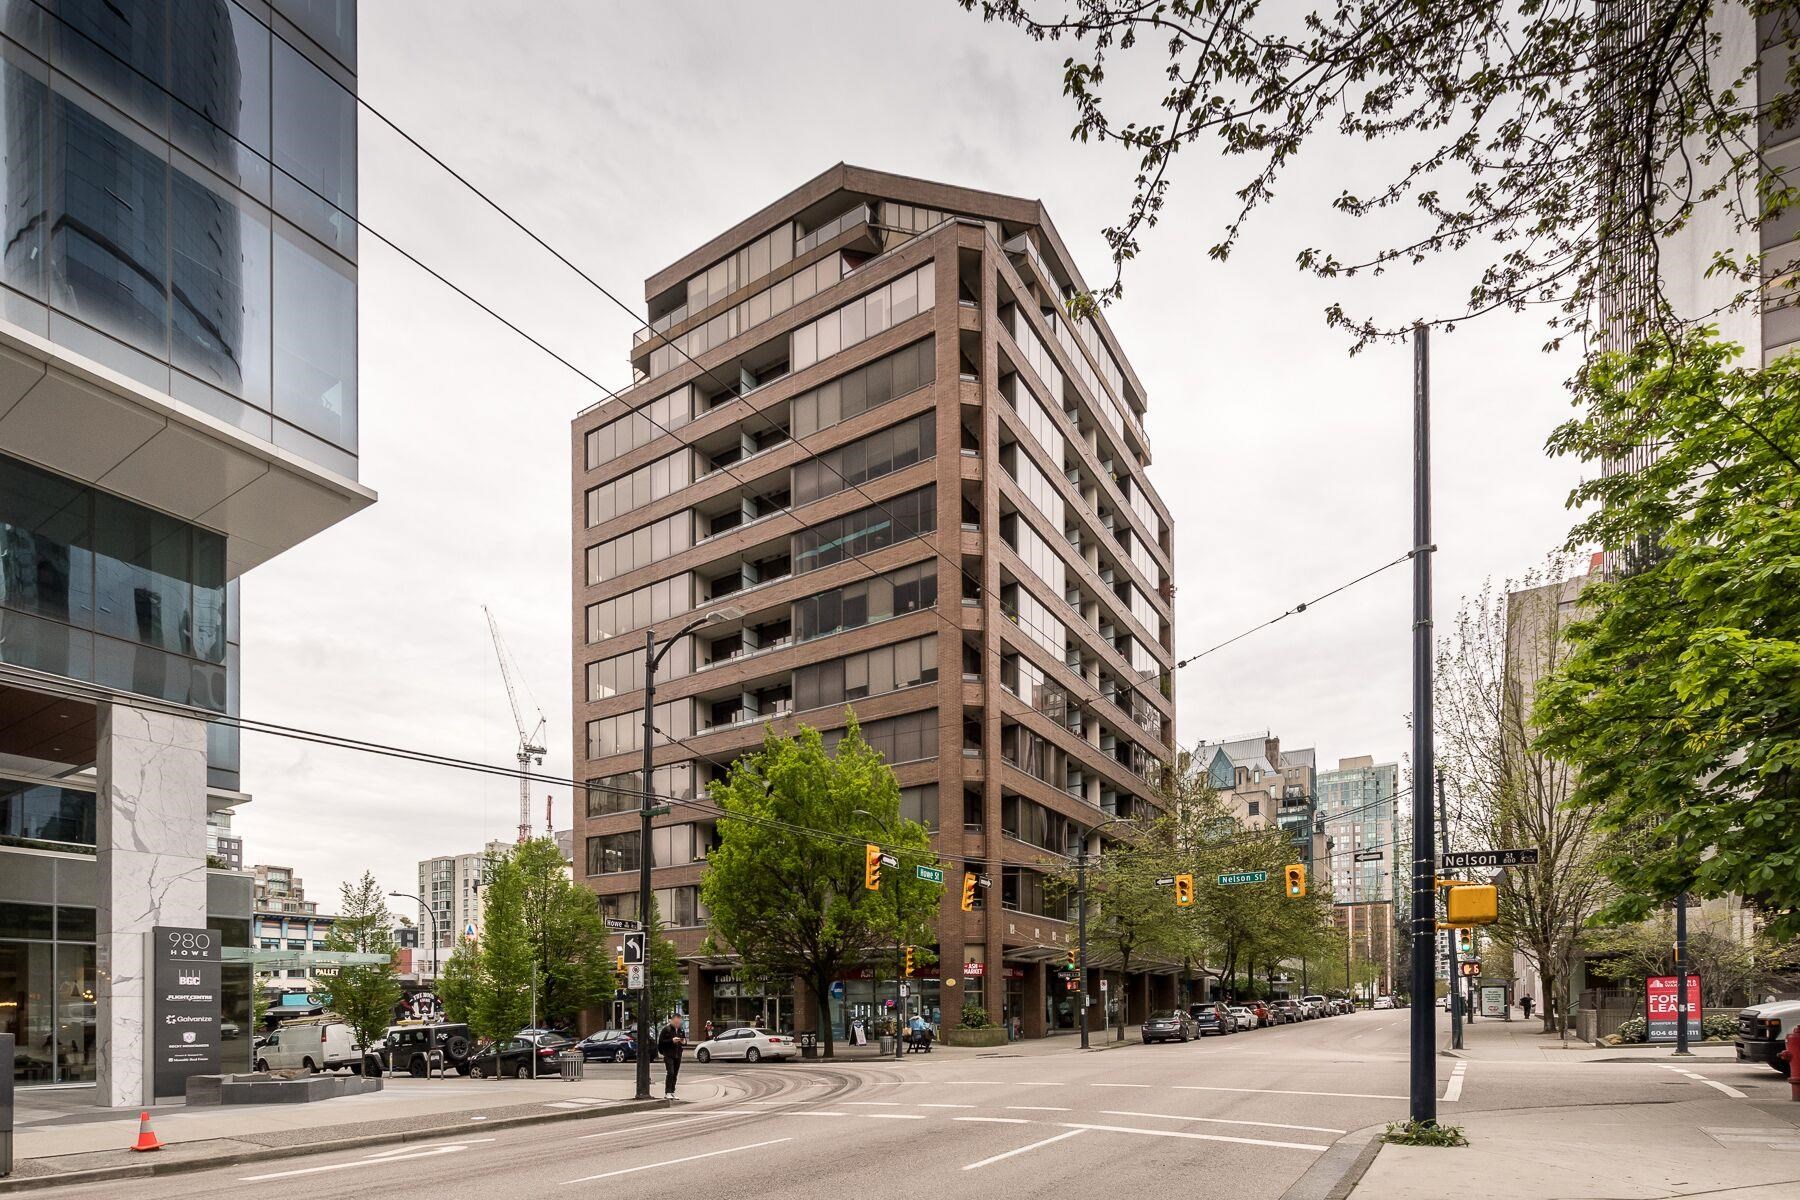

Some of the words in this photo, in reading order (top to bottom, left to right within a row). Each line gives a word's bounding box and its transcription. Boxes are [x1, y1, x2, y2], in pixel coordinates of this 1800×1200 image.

[1445, 854, 1497, 867] Nelson
[920, 868, 933, 880] Howe
[934, 872, 940, 881] St
[1222, 875, 1251, 883] Nelson
[1254, 873, 1263, 881] St
[606, 920, 623, 928] Howe
[169, 932, 210, 949] 980
[170, 949, 209, 957] HOWE
[315, 968, 339, 976] PALLET
[179, 976, 200, 985] BGC
[1649, 994, 1678, 1003] FOR
[1649, 1003, 1696, 1012] LEAE
